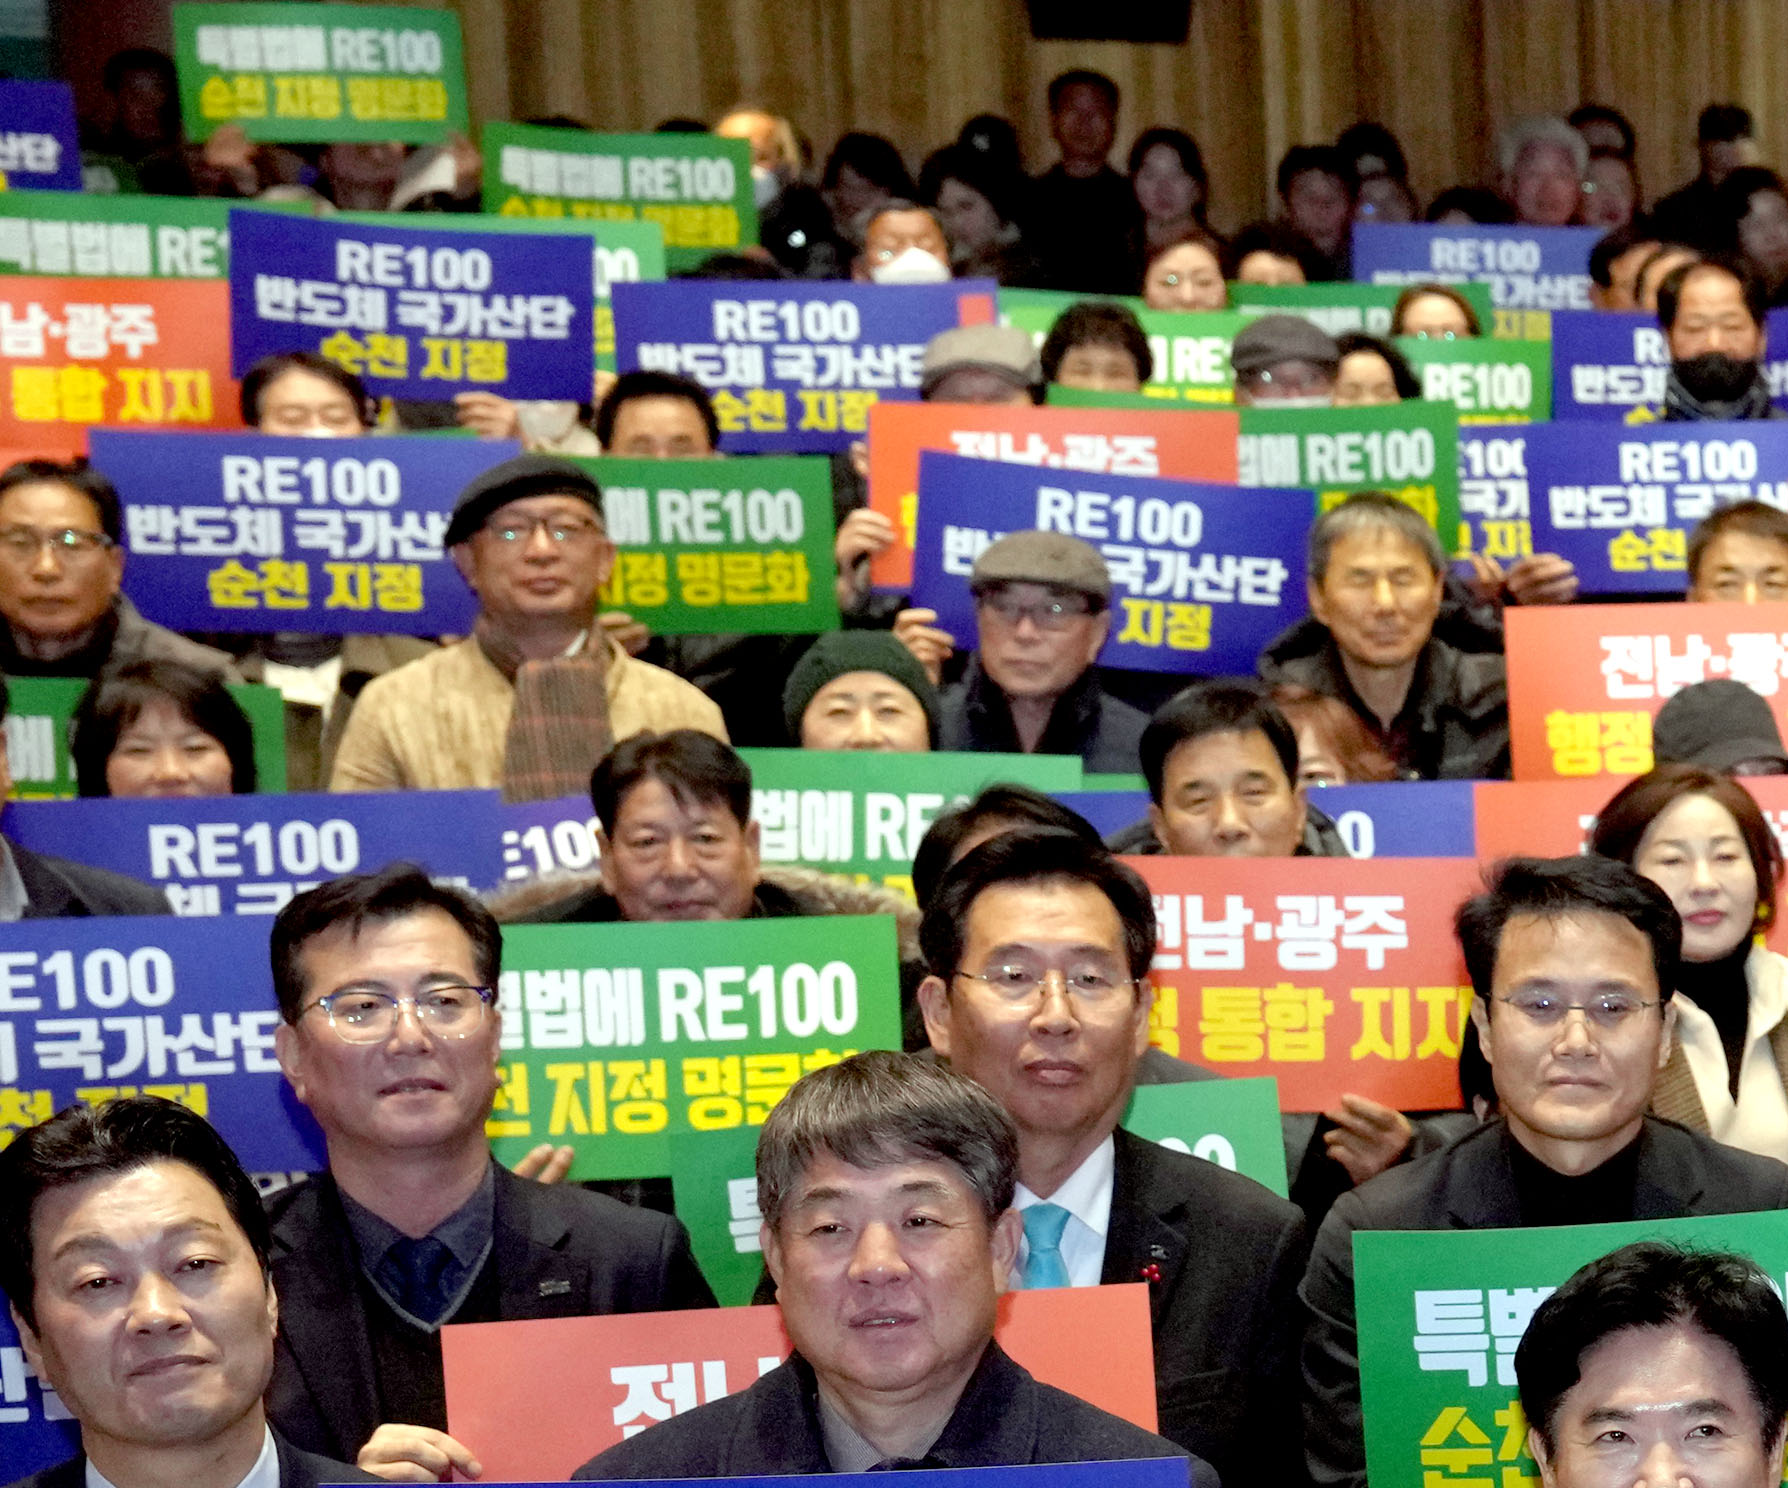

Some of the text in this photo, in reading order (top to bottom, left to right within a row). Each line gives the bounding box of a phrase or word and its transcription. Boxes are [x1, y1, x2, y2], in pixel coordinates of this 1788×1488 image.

[331, 28, 442, 75] RE100
[628, 156, 736, 200] RE100
[336, 239, 491, 292] RE100
[1430, 238, 1541, 273] RE100
[255, 274, 576, 340] 반도체 국가산단
[712, 300, 860, 342] RE100
[320, 330, 508, 382] 순천 지정
[117, 369, 213, 422] 지지
[1425, 363, 1532, 409] RE100
[222, 456, 399, 507] RE100
[1305, 428, 1434, 485] RE100
[1618, 440, 1758, 482] RE100
[127, 505, 284, 558] 반도체
[657, 490, 803, 543] RE100
[1035, 486, 1203, 549] RE100
[1549, 484, 1667, 529] 반도체
[1609, 527, 1687, 571] 순천
[209, 560, 423, 613] 순천 지정
[676, 550, 809, 604] 명문화
[1116, 602, 1212, 651] 지정
[1545, 709, 1653, 778] 행정
[148, 819, 360, 879] RE100
[657, 961, 859, 1044] RE100
[1200, 981, 1476, 1064] 통합 지지
[487, 1058, 669, 1138] 천 지정
